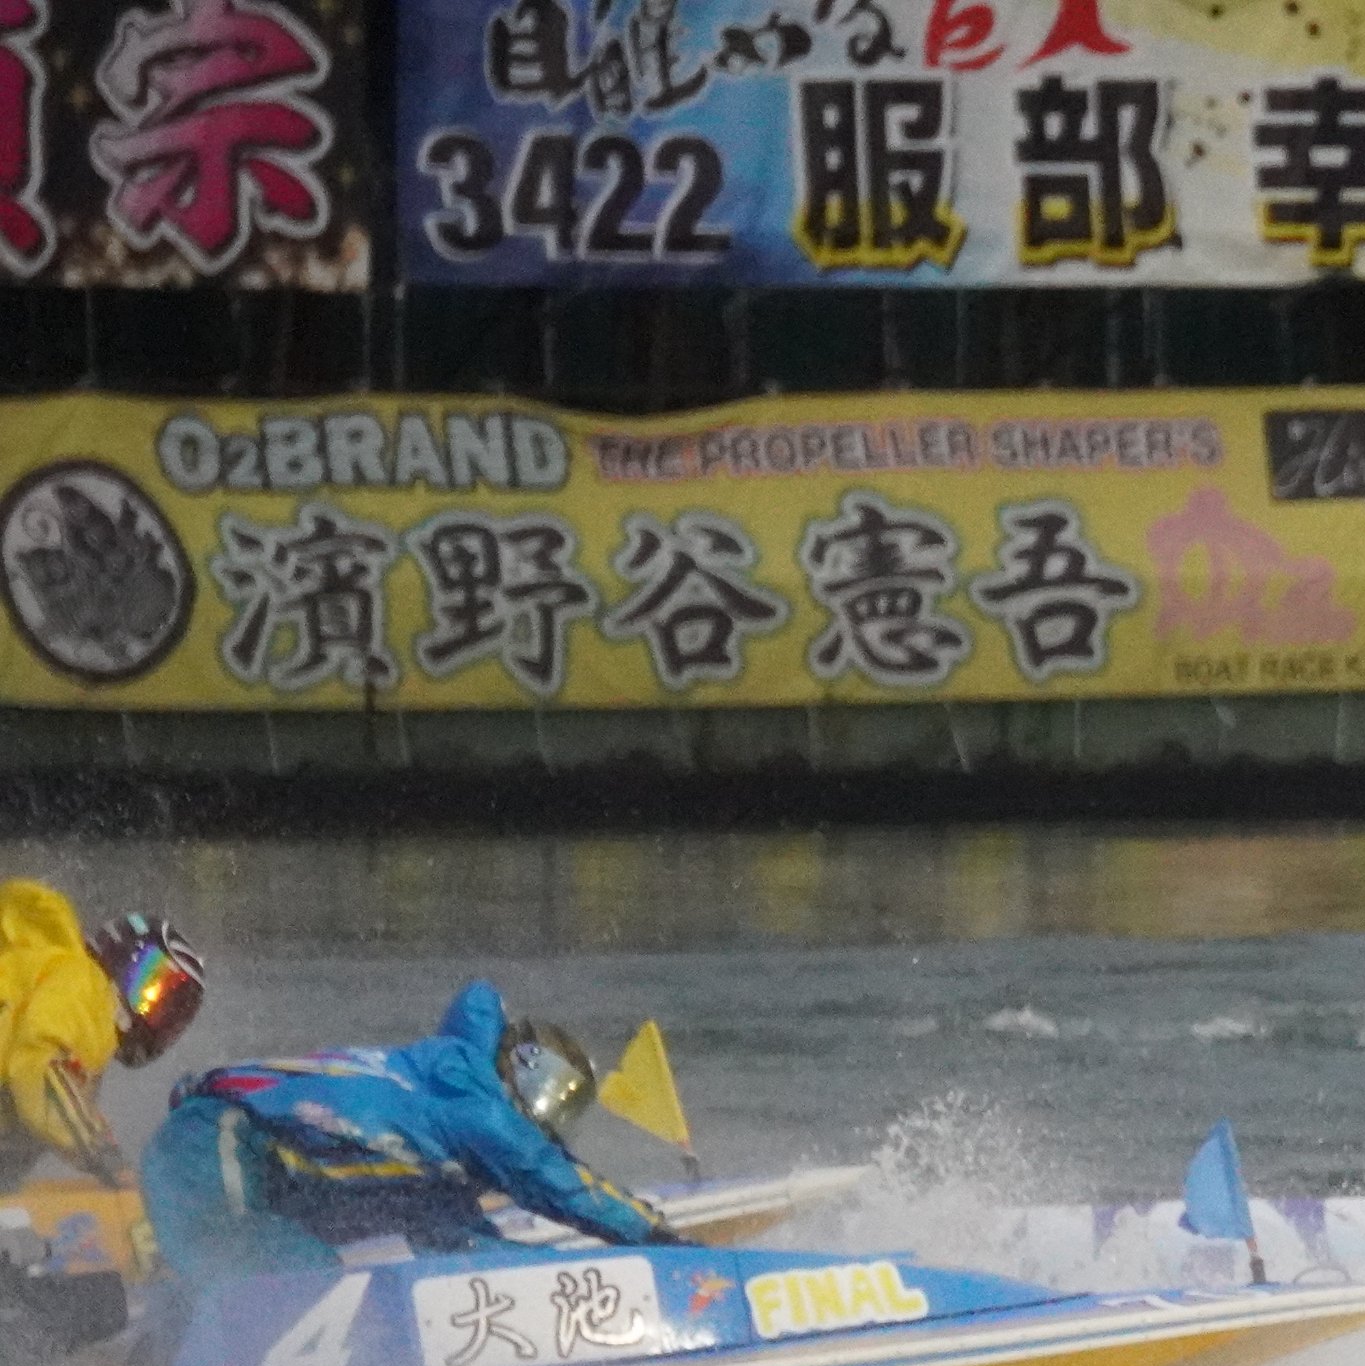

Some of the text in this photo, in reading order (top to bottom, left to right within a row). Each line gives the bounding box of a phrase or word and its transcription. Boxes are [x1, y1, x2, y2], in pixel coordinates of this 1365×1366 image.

[420, 132, 733, 262] 3422
[157, 414, 570, 490] O2BRAND
[596, 434, 684, 480] THE
[697, 421, 977, 476] PROPELLER
[212, 492, 1142, 692] 濱野谷憲吾
[745, 1262, 929, 1340] FINAL
